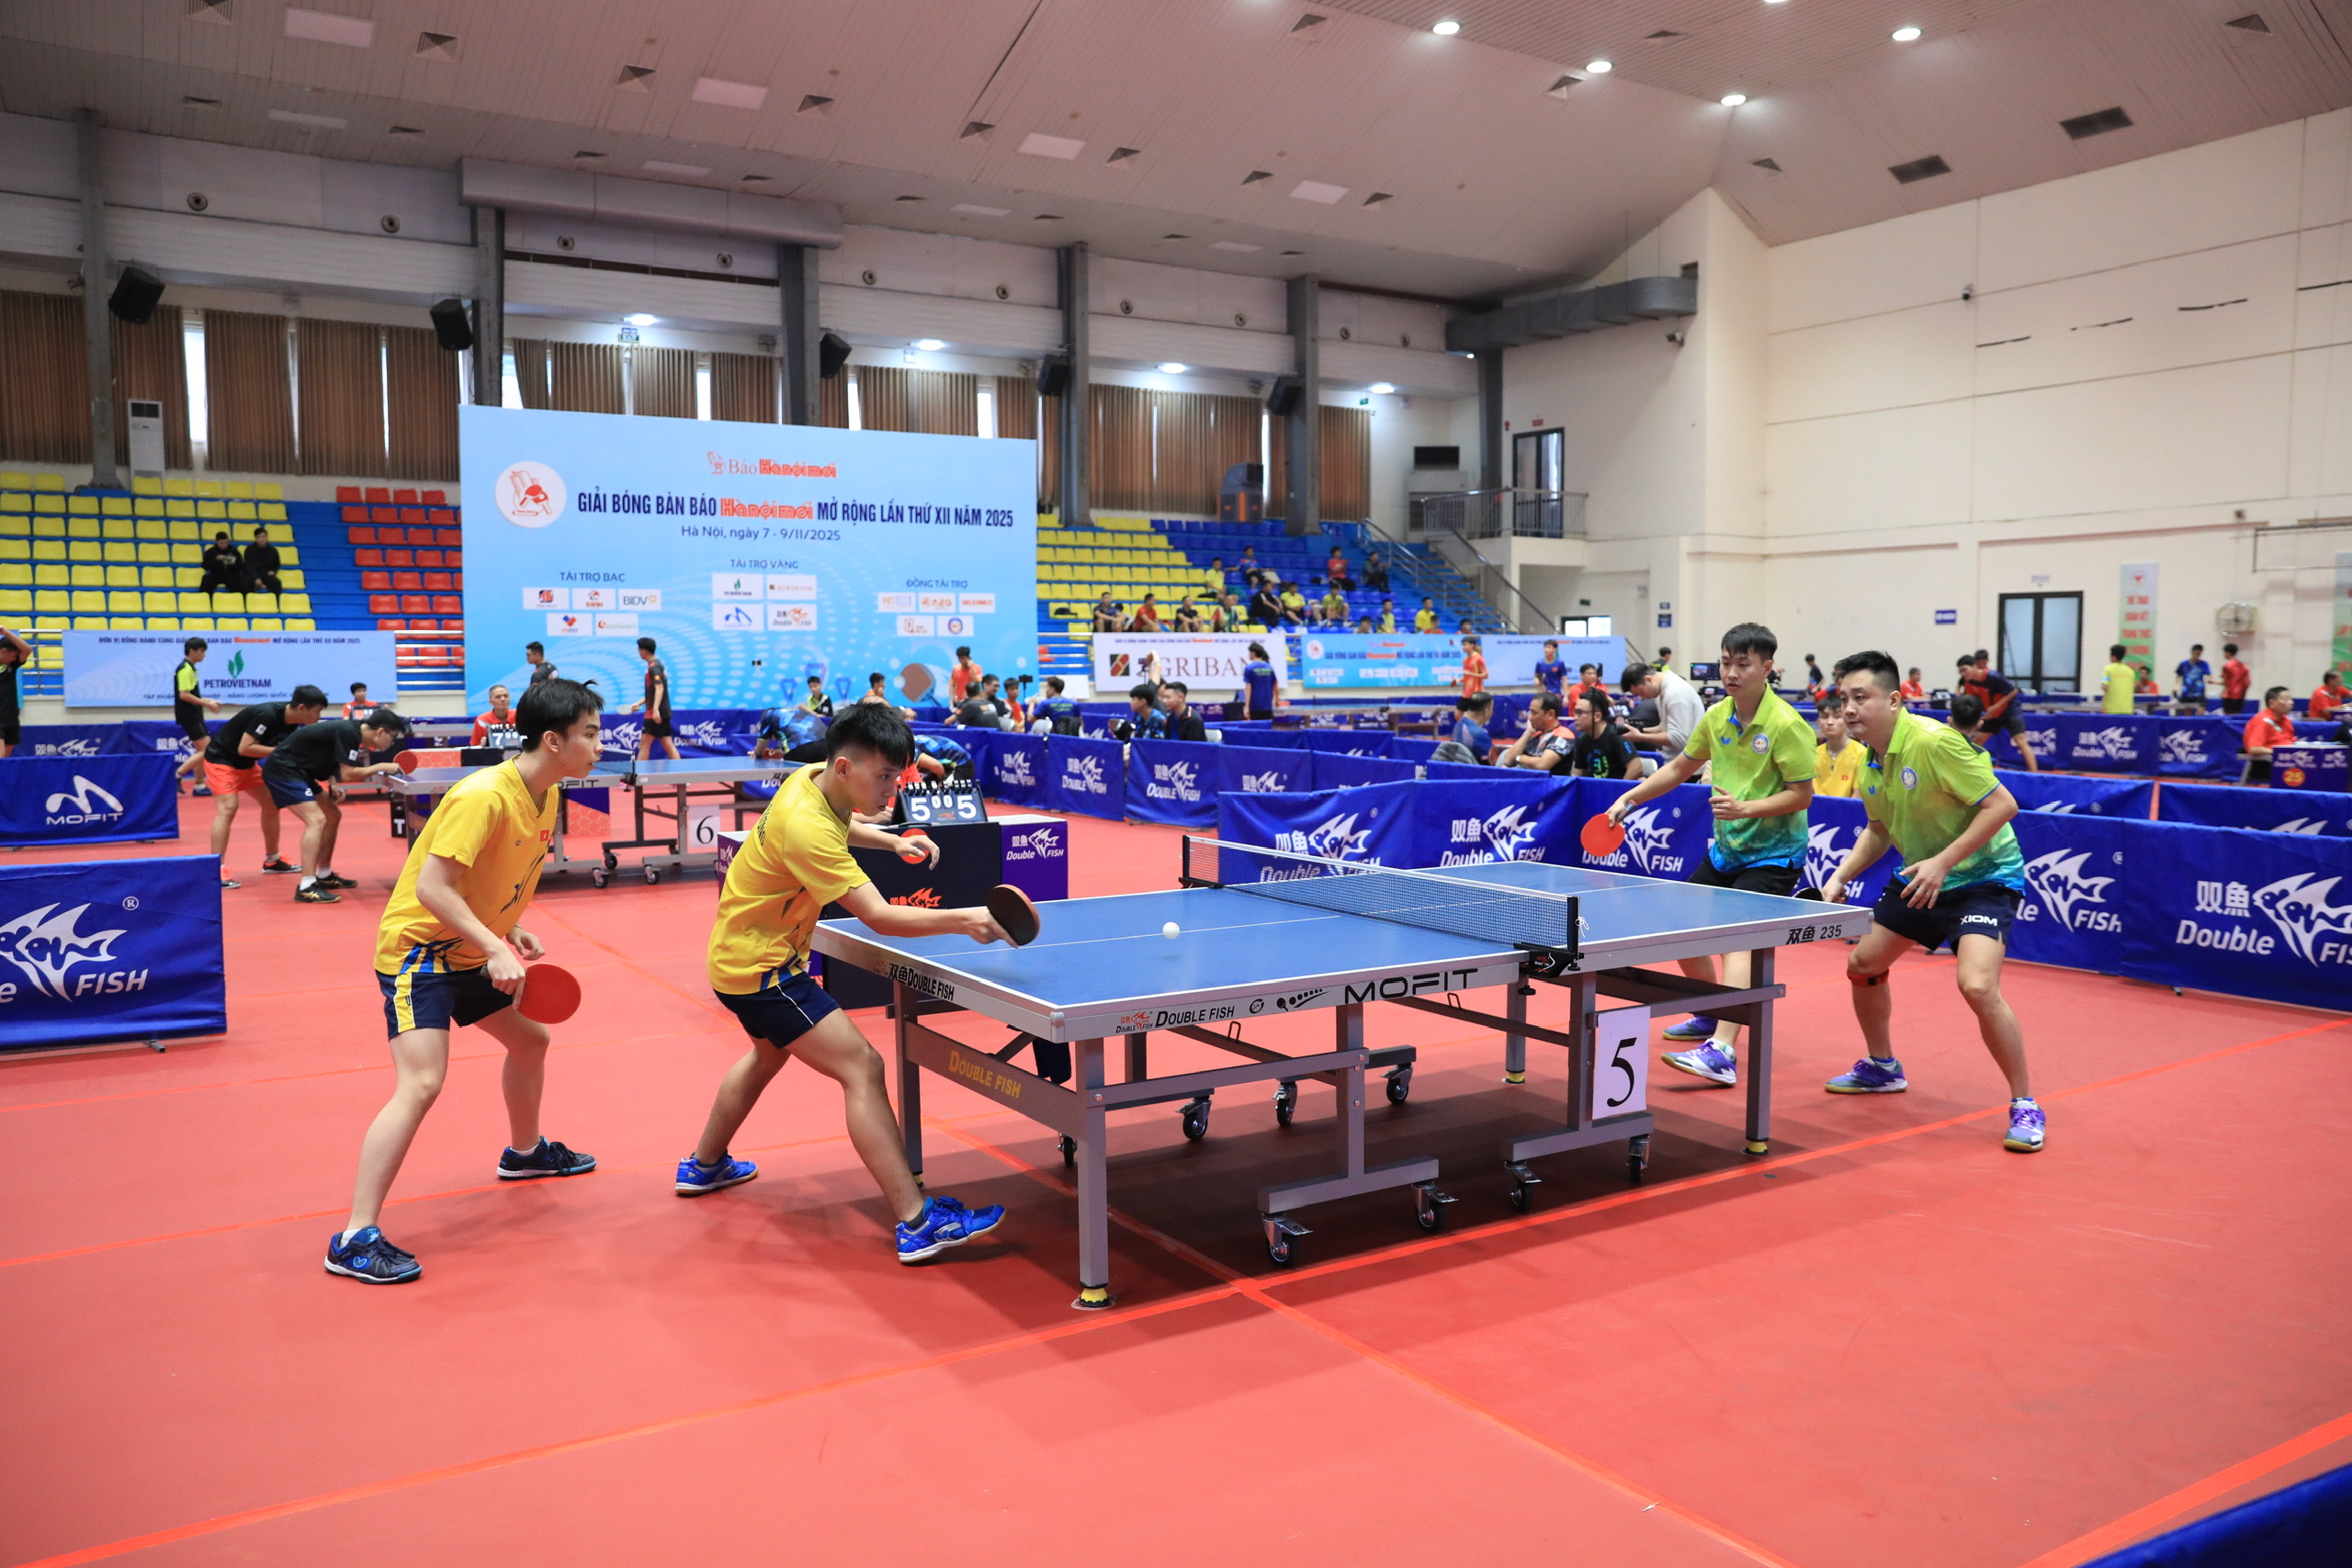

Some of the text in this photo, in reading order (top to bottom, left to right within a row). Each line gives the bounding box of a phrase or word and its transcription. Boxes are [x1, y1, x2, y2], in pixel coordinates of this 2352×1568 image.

[729, 459, 757, 475] Báo
[578, 485, 607, 513] GIẢI
[612, 490, 651, 514] BÓNG
[656, 491, 684, 515] BÀN
[689, 493, 717, 517] BÁO
[818, 496, 838, 521] MỞ
[842, 500, 876, 526] RỘNG
[909, 502, 933, 525] THỨ
[934, 507, 950, 525] XII
[955, 503, 982, 526] NĂM
[986, 509, 1013, 527] 2025
[681, 525, 699, 536] Hà
[702, 525, 727, 539] Nội,
[730, 527, 759, 540] ngày
[763, 528, 770, 538] 7
[780, 528, 841, 541] 9/11/2025
[560, 570, 577, 581] TÀI
[623, 595, 648, 605] BIDV
[204, 679, 271, 688] PETROVIETNAM
[492, 733, 503, 745] 7
[1147, 783, 1177, 799] DOUBLE
[911, 797, 931, 821] 5
[932, 795, 942, 809] 0
[943, 795, 953, 808] 0
[956, 795, 977, 819] 5
[46, 812, 123, 825] MOFIT
[696, 815, 714, 844] 6
[1006, 848, 1064, 861] Double FISH
[1440, 847, 1545, 867] Double FISH
[1582, 849, 1684, 873] Double FISH
[1960, 915, 1998, 927] XIOM
[1786, 924, 1842, 945] 双鱼 235
[2176, 919, 2275, 955] Double
[74, 968, 149, 997] FISH
[908, 968, 937, 995] DOUBLE
[937, 981, 955, 1001] FISH
[1345, 968, 1478, 1005] MOFIT
[1155, 1005, 1236, 1028] DOUBLE FISH
[1115, 1023, 1136, 1033] DOUBLE
[948, 1050, 1022, 1099] DOUBLE FISH
[1606, 1037, 1637, 1108] 5
